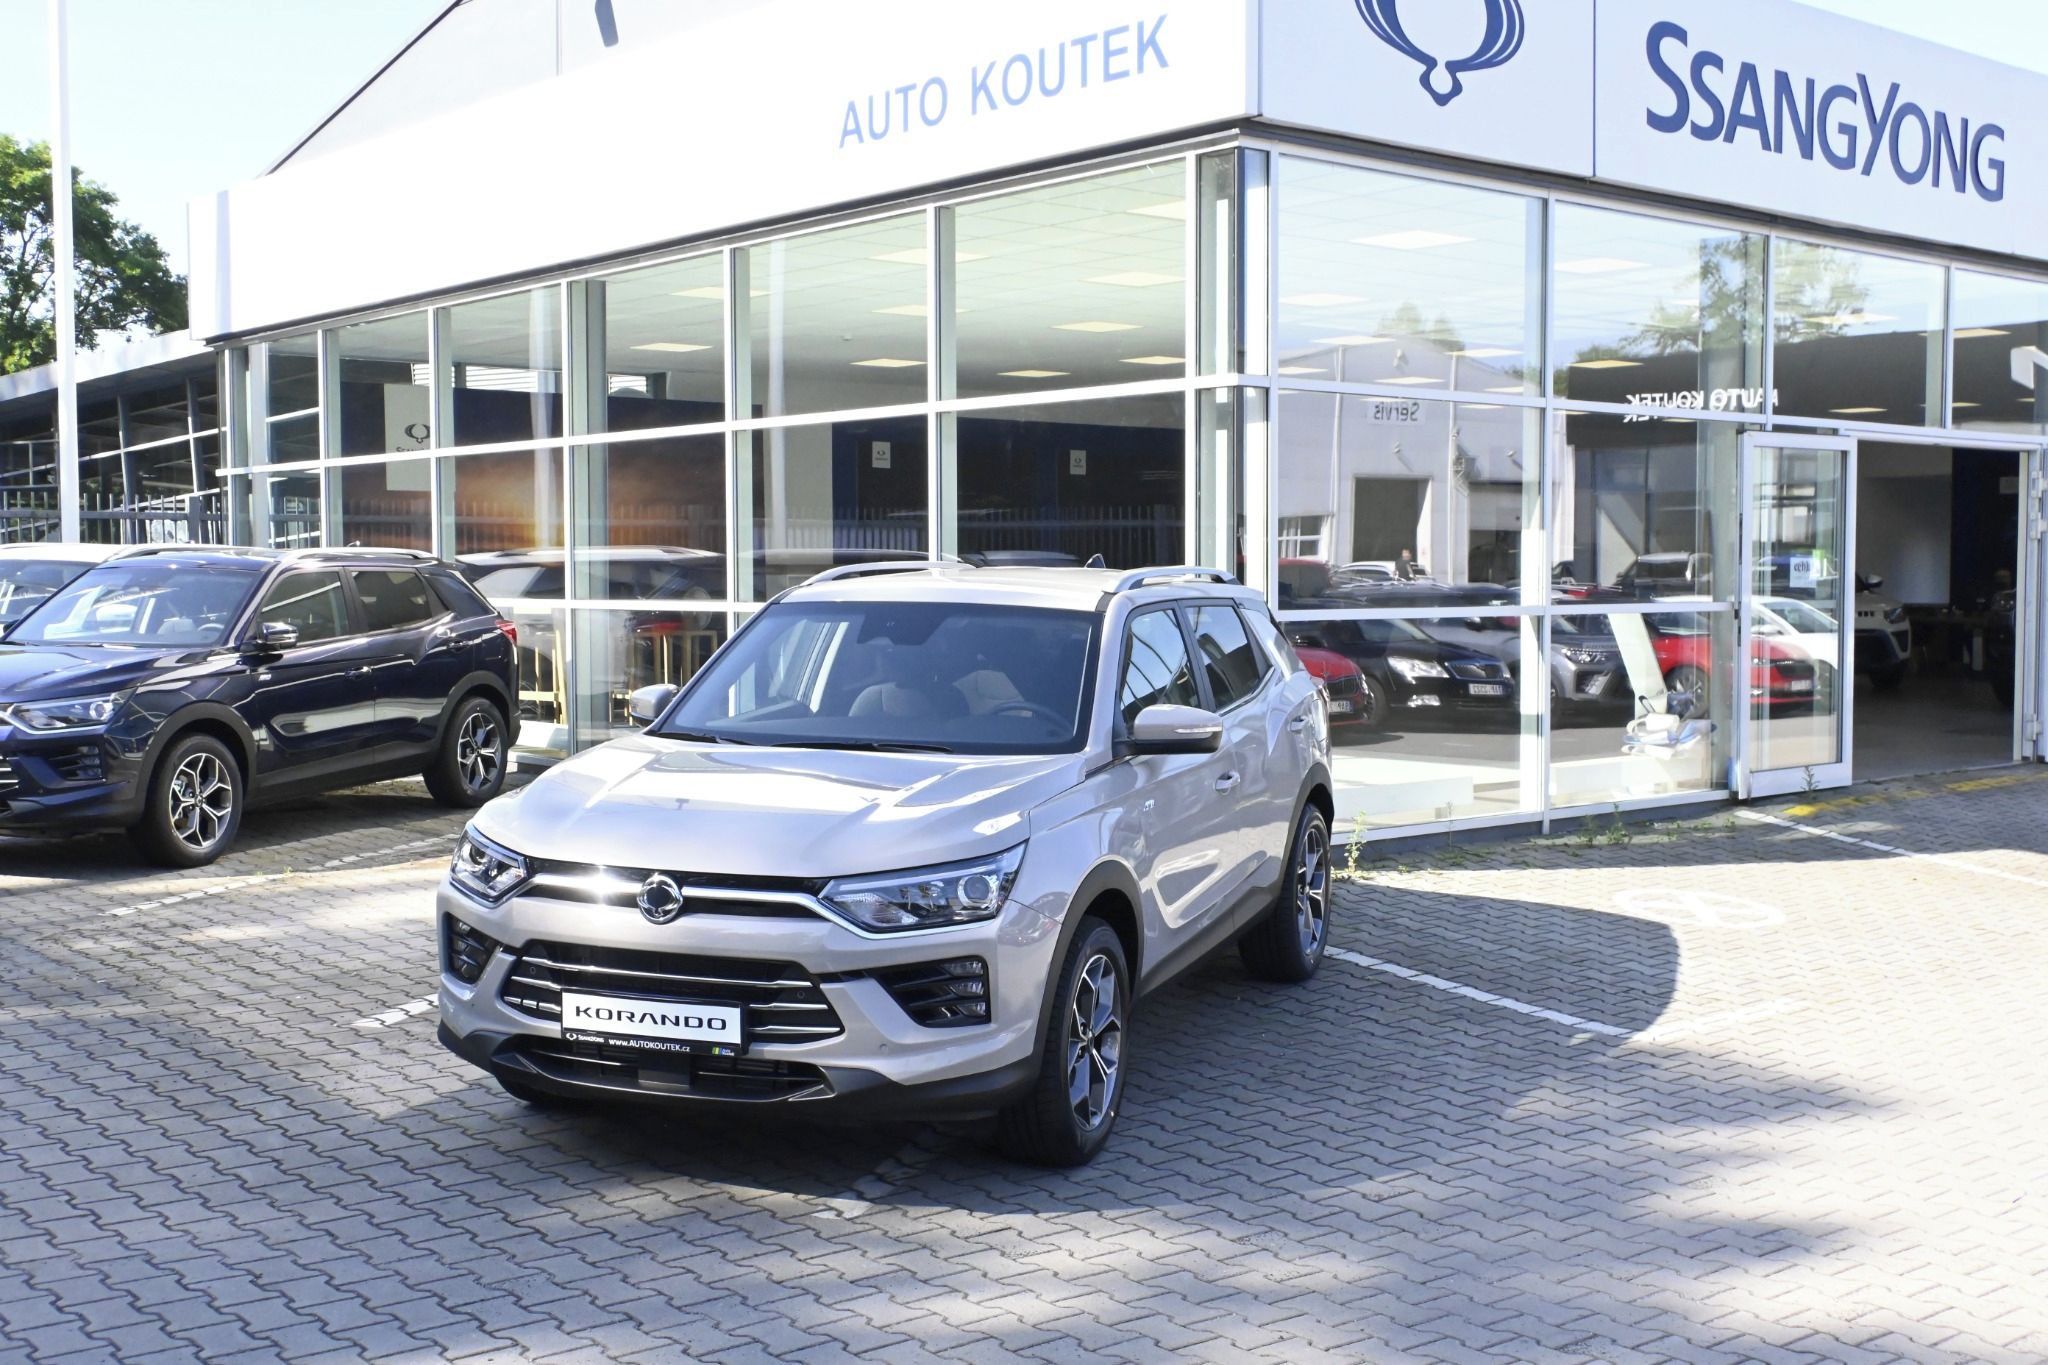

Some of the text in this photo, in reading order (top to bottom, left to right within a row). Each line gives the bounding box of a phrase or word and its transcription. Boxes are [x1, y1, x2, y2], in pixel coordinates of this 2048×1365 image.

[838, 13, 1170, 149] AUTO KOUTEK
[575, 1005, 727, 1031] KORANDO
[608, 1038, 691, 1053] www.AUTOKOUTEK.cz
